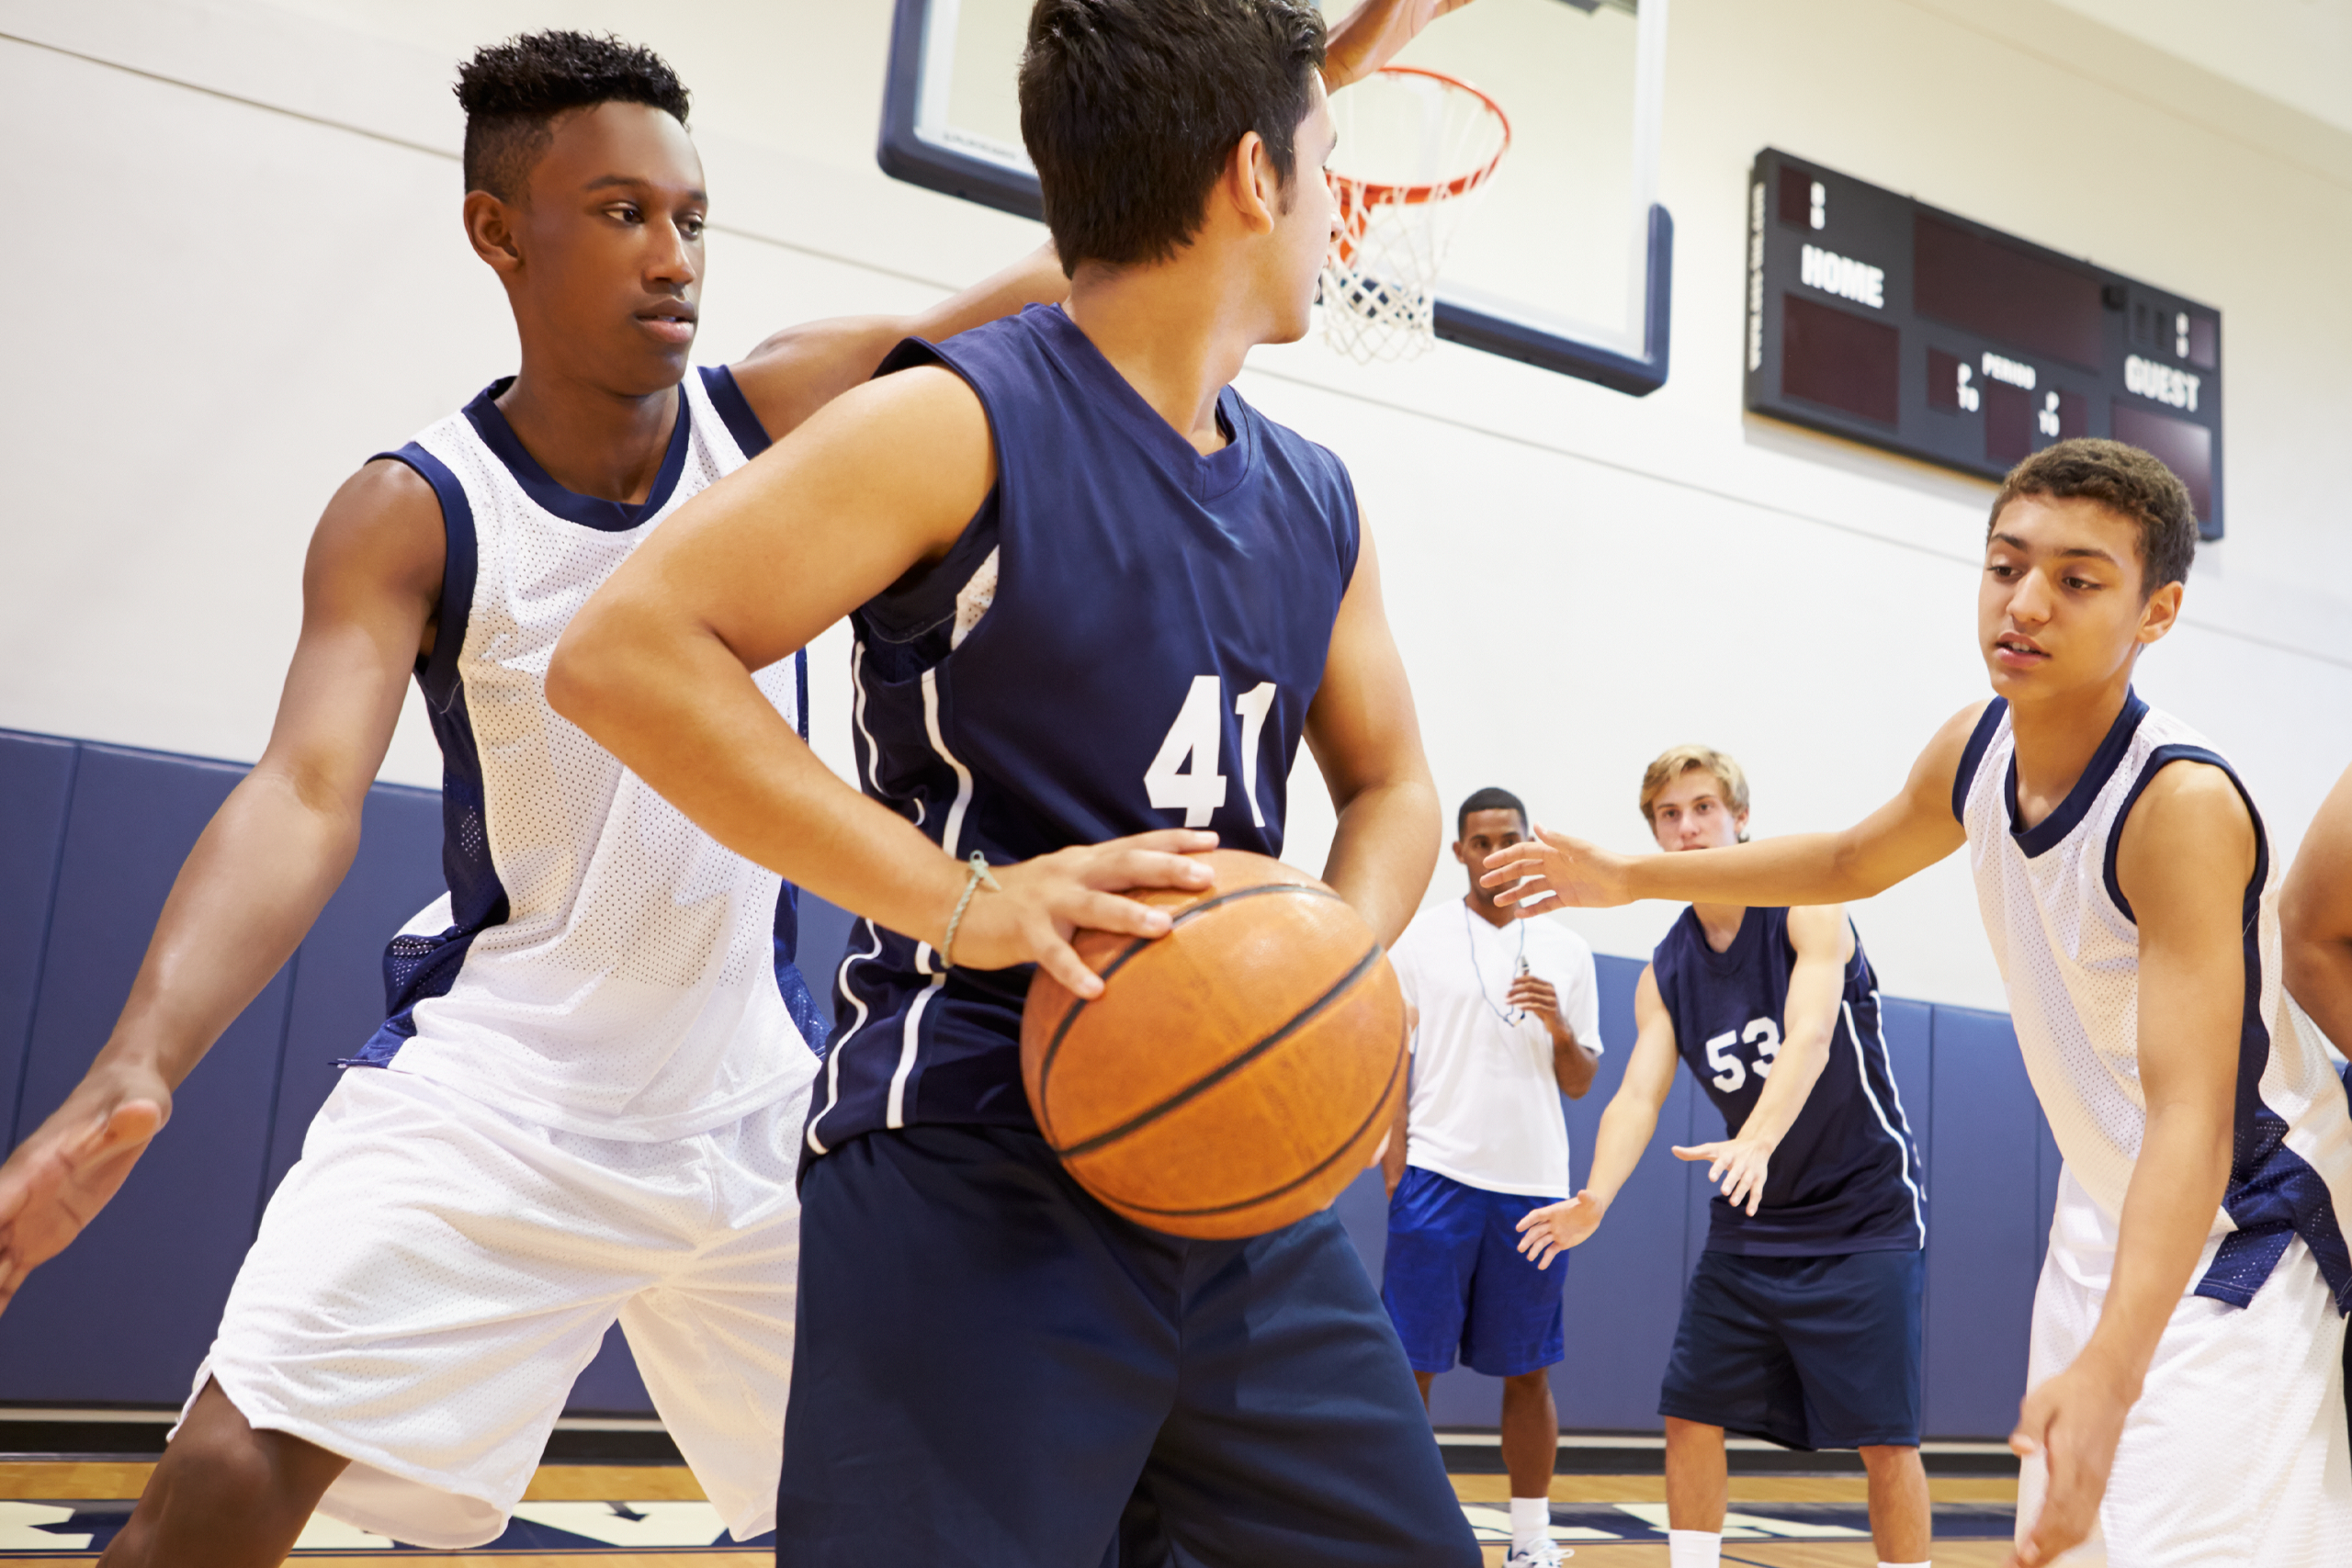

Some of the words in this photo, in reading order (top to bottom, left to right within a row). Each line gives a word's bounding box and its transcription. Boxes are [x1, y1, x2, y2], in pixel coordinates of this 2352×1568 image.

[1802, 244, 1884, 310] HOME
[1982, 352, 2036, 390] PERIOD
[2124, 355, 2200, 412] GUEST
[1144, 675, 1277, 828] 41
[1705, 1016, 1782, 1093] 53
